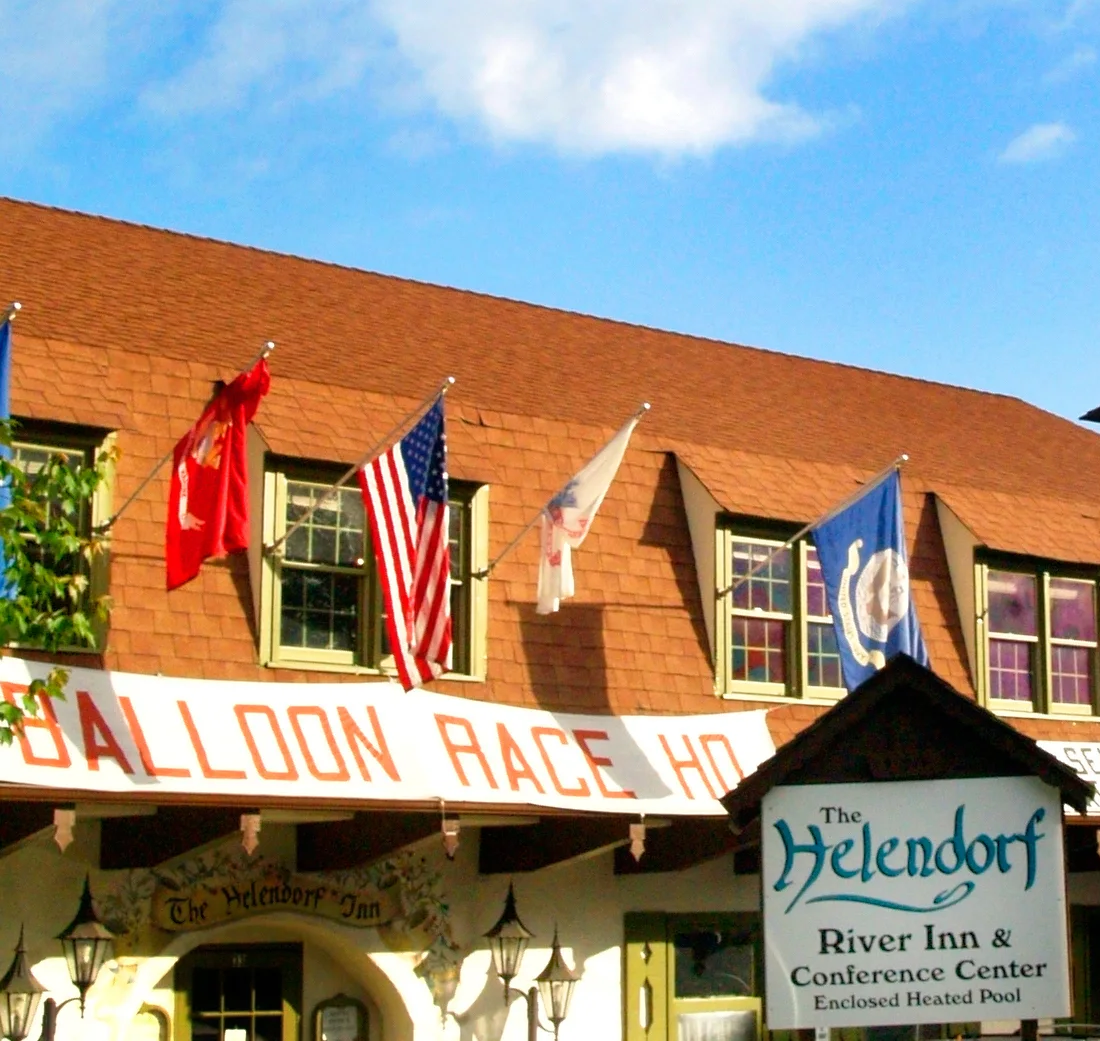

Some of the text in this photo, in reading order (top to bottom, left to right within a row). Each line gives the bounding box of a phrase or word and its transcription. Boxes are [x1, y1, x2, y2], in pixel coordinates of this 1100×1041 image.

[1, 681, 402, 782] BALLOON
[434, 713, 638, 799] RACE
[820, 807, 862, 824] The
[773, 804, 1046, 914] Helendorf
[165, 881, 381, 924] The Helendorf Inn
[818, 924, 1012, 955] River Inn &
[790, 959, 1048, 987] Conference Center
[814, 987, 1021, 1010] Enclosed Heated Pool
